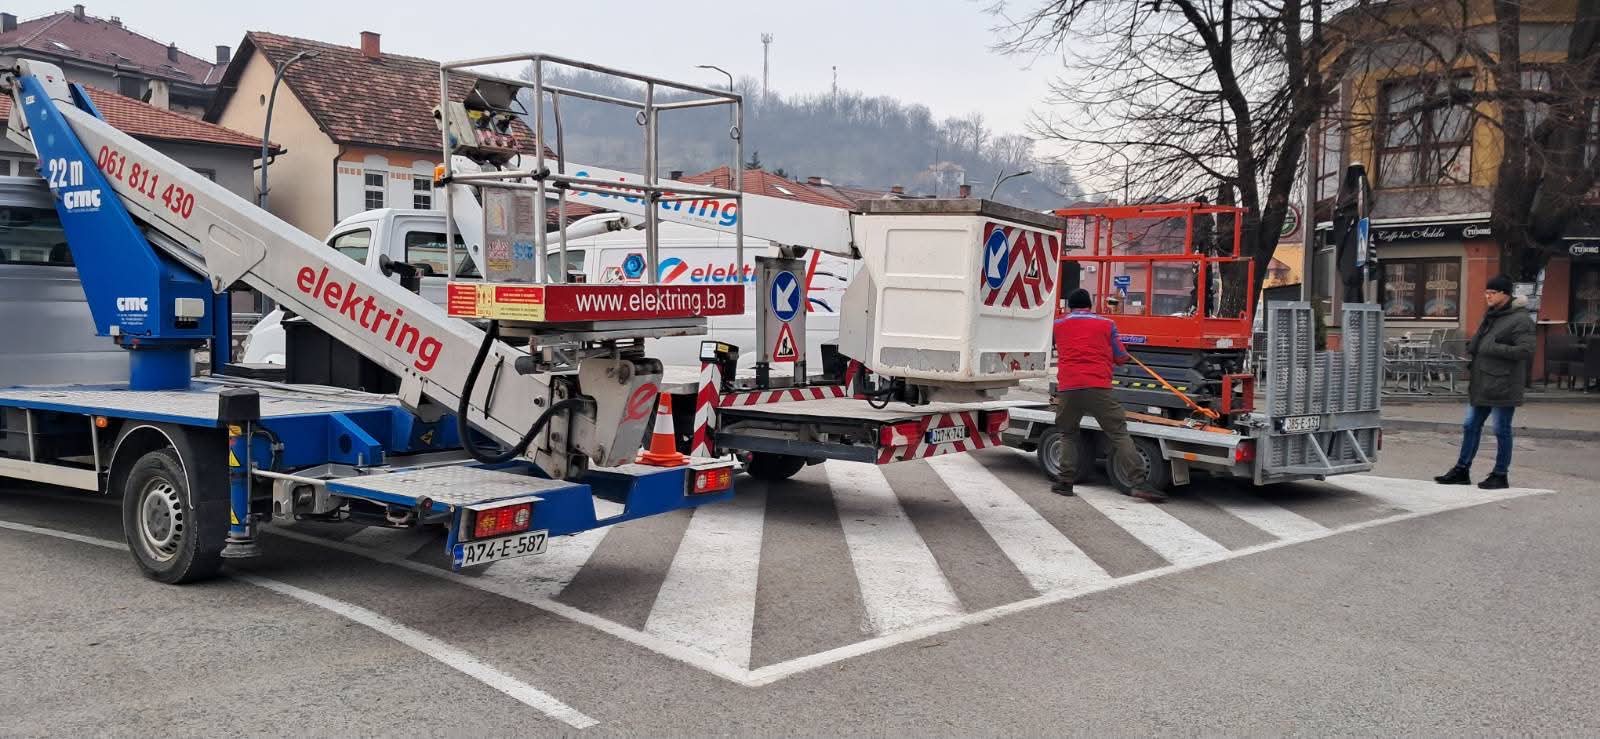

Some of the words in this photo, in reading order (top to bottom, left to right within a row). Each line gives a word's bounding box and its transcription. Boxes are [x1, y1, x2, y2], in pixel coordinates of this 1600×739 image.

[49, 158, 68, 188] 22
[70, 160, 83, 187] m
[97, 145, 126, 181] 061
[128, 162, 159, 200] 811
[161, 183, 195, 219] 430
[576, 288, 726, 315] www.elektring.ba
[296, 266, 443, 372] elektring
[464, 533, 546, 564] A74-E-587
